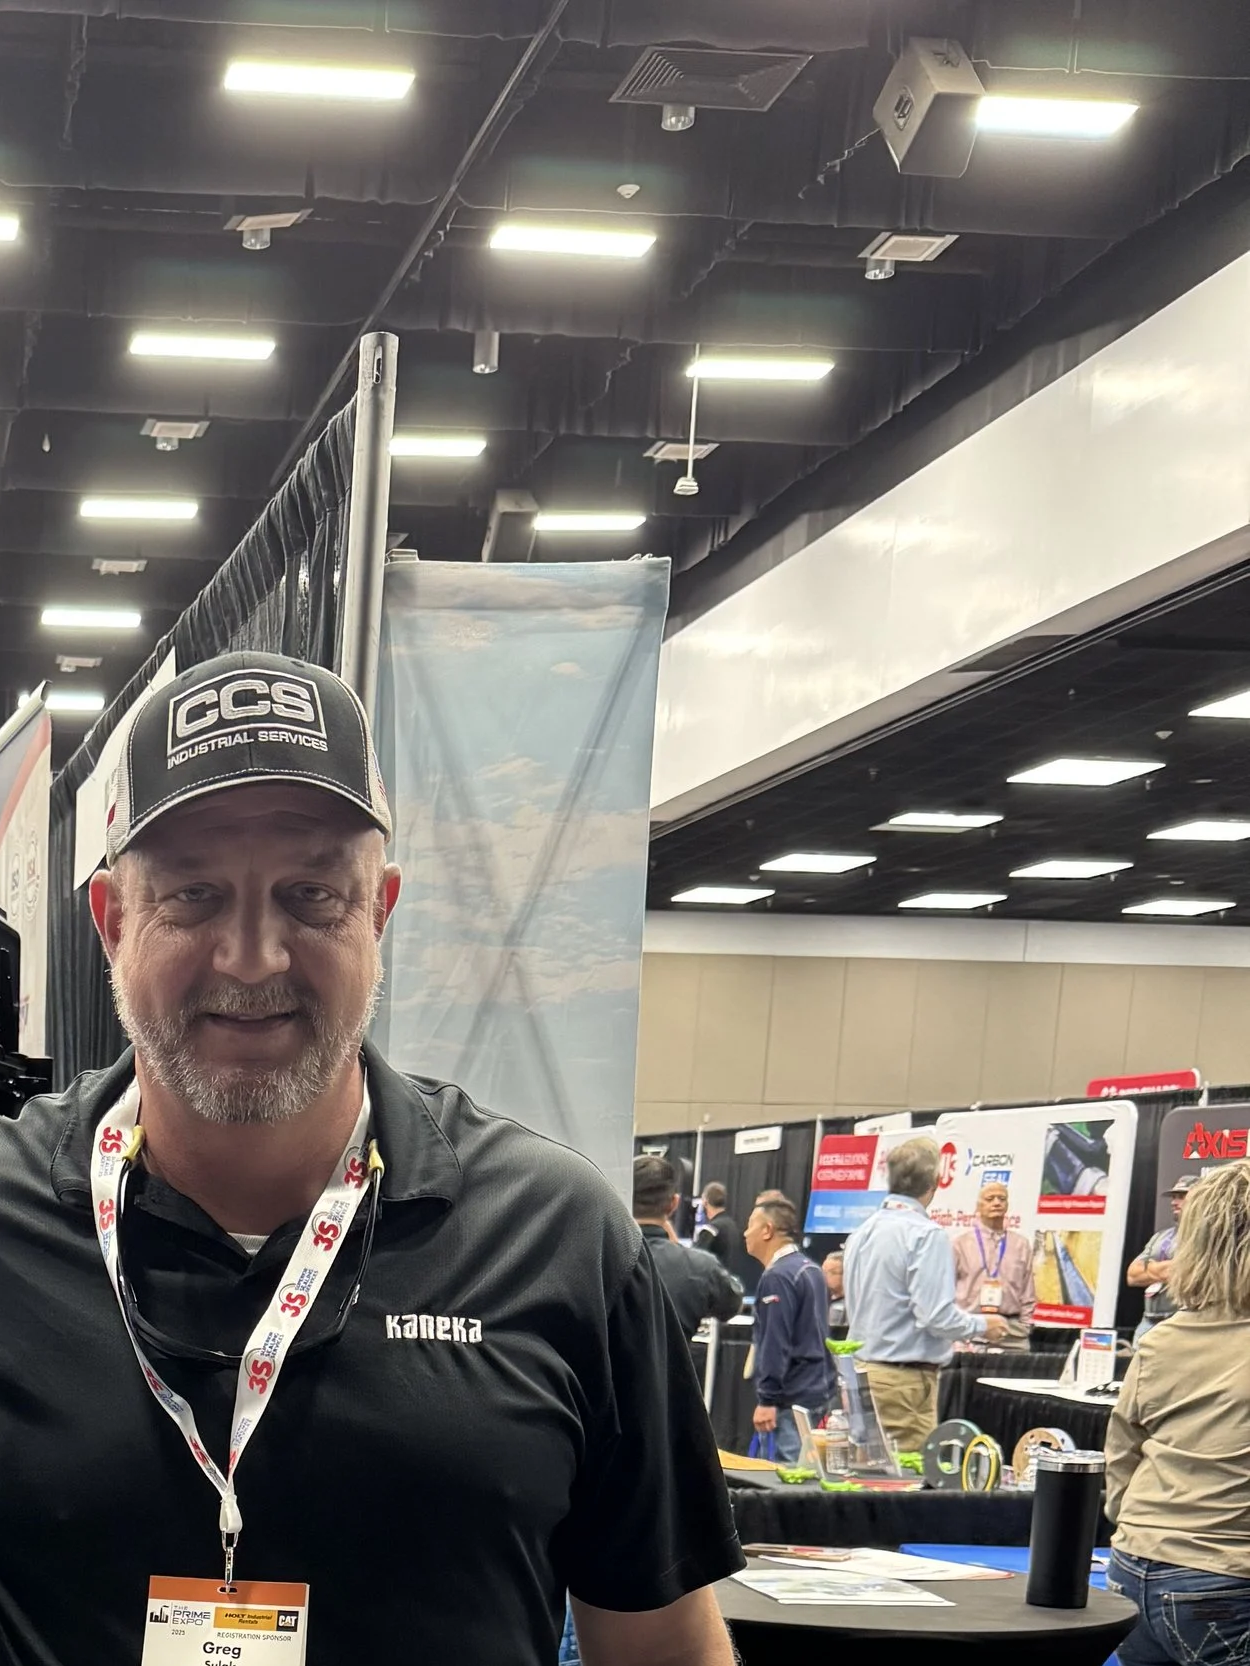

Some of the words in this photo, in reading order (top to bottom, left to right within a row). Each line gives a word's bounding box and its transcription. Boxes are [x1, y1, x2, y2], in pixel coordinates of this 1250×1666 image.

[176, 680, 315, 738] CCS
[167, 731, 254, 769] INDUSTRIAL
[258, 730, 328, 751] SERVICES
[102, 1127, 123, 1153] 3S
[1183, 1122, 1248, 1159] AXIS
[344, 1157, 368, 1189] 3S
[972, 1154, 1014, 1167] CARBON
[99, 1199, 115, 1230] 3S
[313, 1221, 339, 1251] 3S
[280, 1293, 307, 1317] 3S
[249, 1359, 272, 1394] 3S
[172, 1609, 211, 1619] PRIME
[172, 1618, 203, 1626] EXPO
[278, 1615, 297, 1627] CAT
[202, 1641, 242, 1659] Greg
[217, 1632, 261, 1640] REGISTRATION
[262, 1634, 292, 1642] SPONSOR
